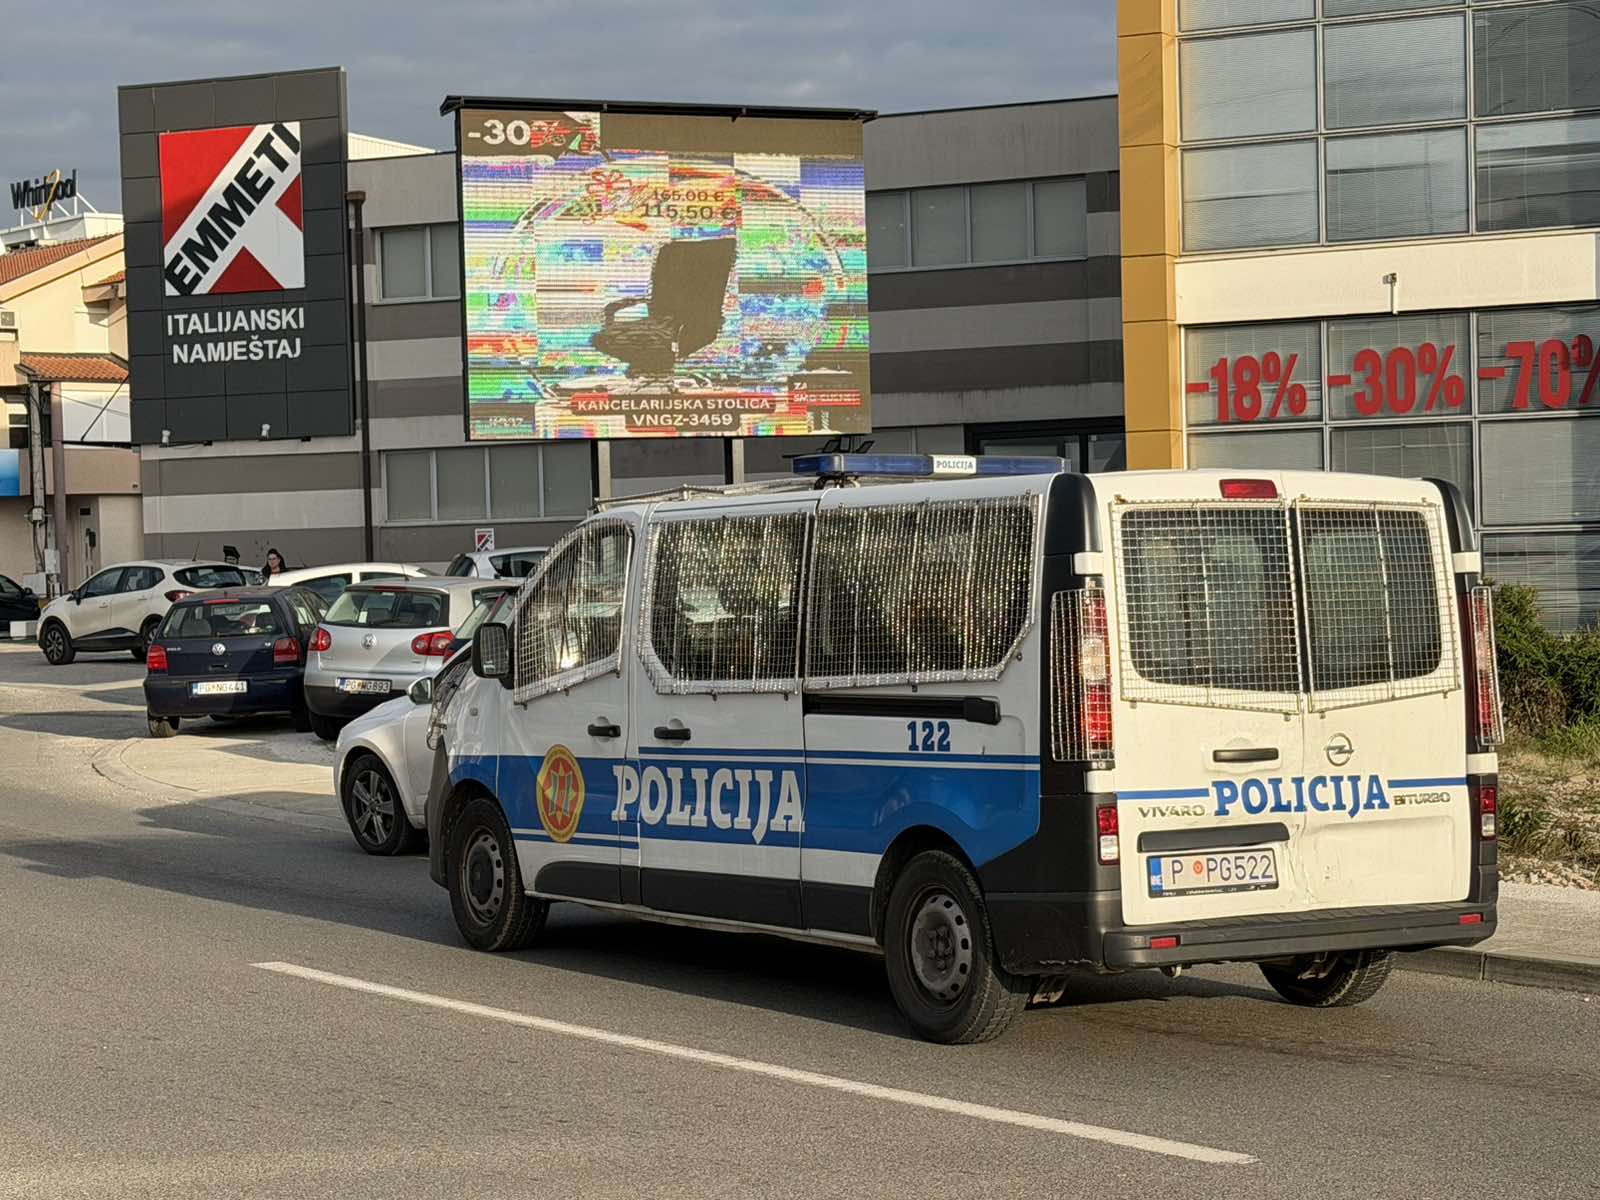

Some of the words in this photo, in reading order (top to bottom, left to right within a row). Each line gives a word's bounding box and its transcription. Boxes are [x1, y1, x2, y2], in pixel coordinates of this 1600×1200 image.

[165, 122, 301, 296] EMMETI
[167, 307, 305, 336] ITALIJANSKI
[173, 336, 301, 364] NAMJEŠTAJ
[1187, 351, 1306, 422] -18%
[1327, 342, 1464, 416] -30%
[578, 400, 703, 411] KANCELARIJSKA
[706, 399, 770, 410] STOLICA
[935, 460, 974, 470] POLICIJA
[907, 720, 951, 752] 122
[611, 764, 806, 845] POLICIJA
[1137, 804, 1206, 818] VIVARO
[1211, 774, 1390, 819] POLICIJA
[1393, 791, 1451, 805] BITURBO
